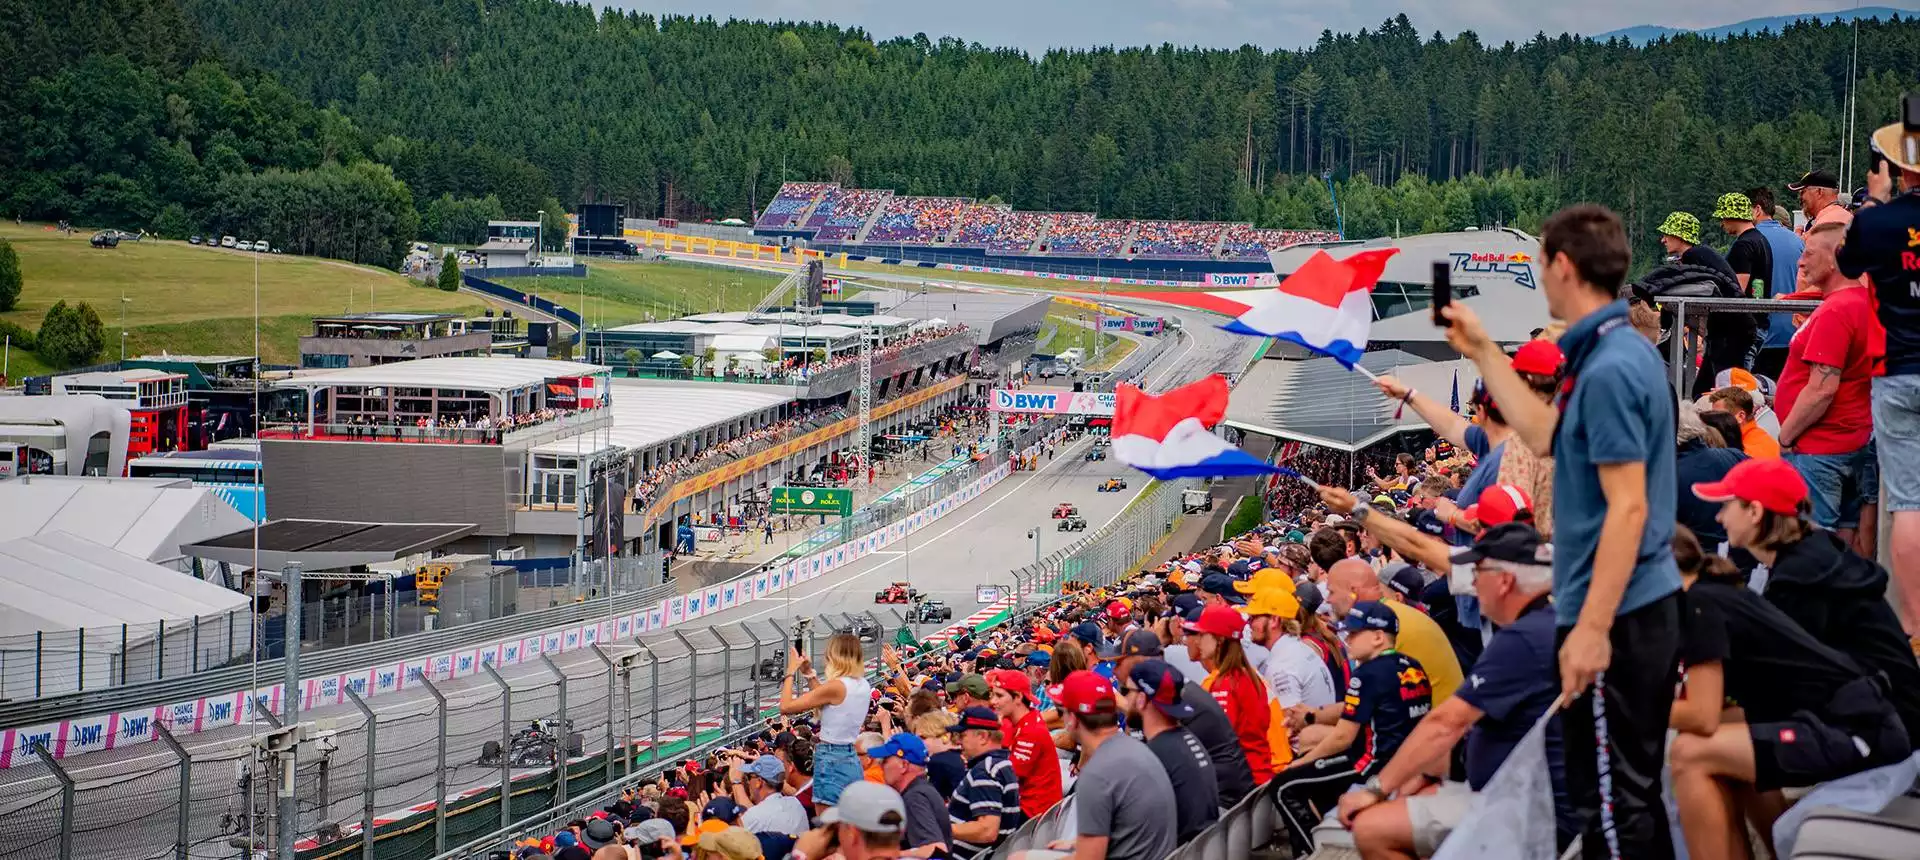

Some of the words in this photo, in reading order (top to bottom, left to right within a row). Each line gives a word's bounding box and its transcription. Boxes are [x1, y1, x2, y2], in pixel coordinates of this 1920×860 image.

[1472, 253, 1488, 262] Red
[1489, 253, 1505, 262] Bull
[1223, 276, 1248, 284] BWT
[1449, 253, 1536, 289] Ring
[1015, 394, 1057, 409] BWT
[174, 703, 193, 716] CHANGE
[215, 701, 231, 720] BWT
[81, 724, 102, 746] BWT
[130, 716, 148, 736] BWT
[28, 732, 51, 755] BWT
